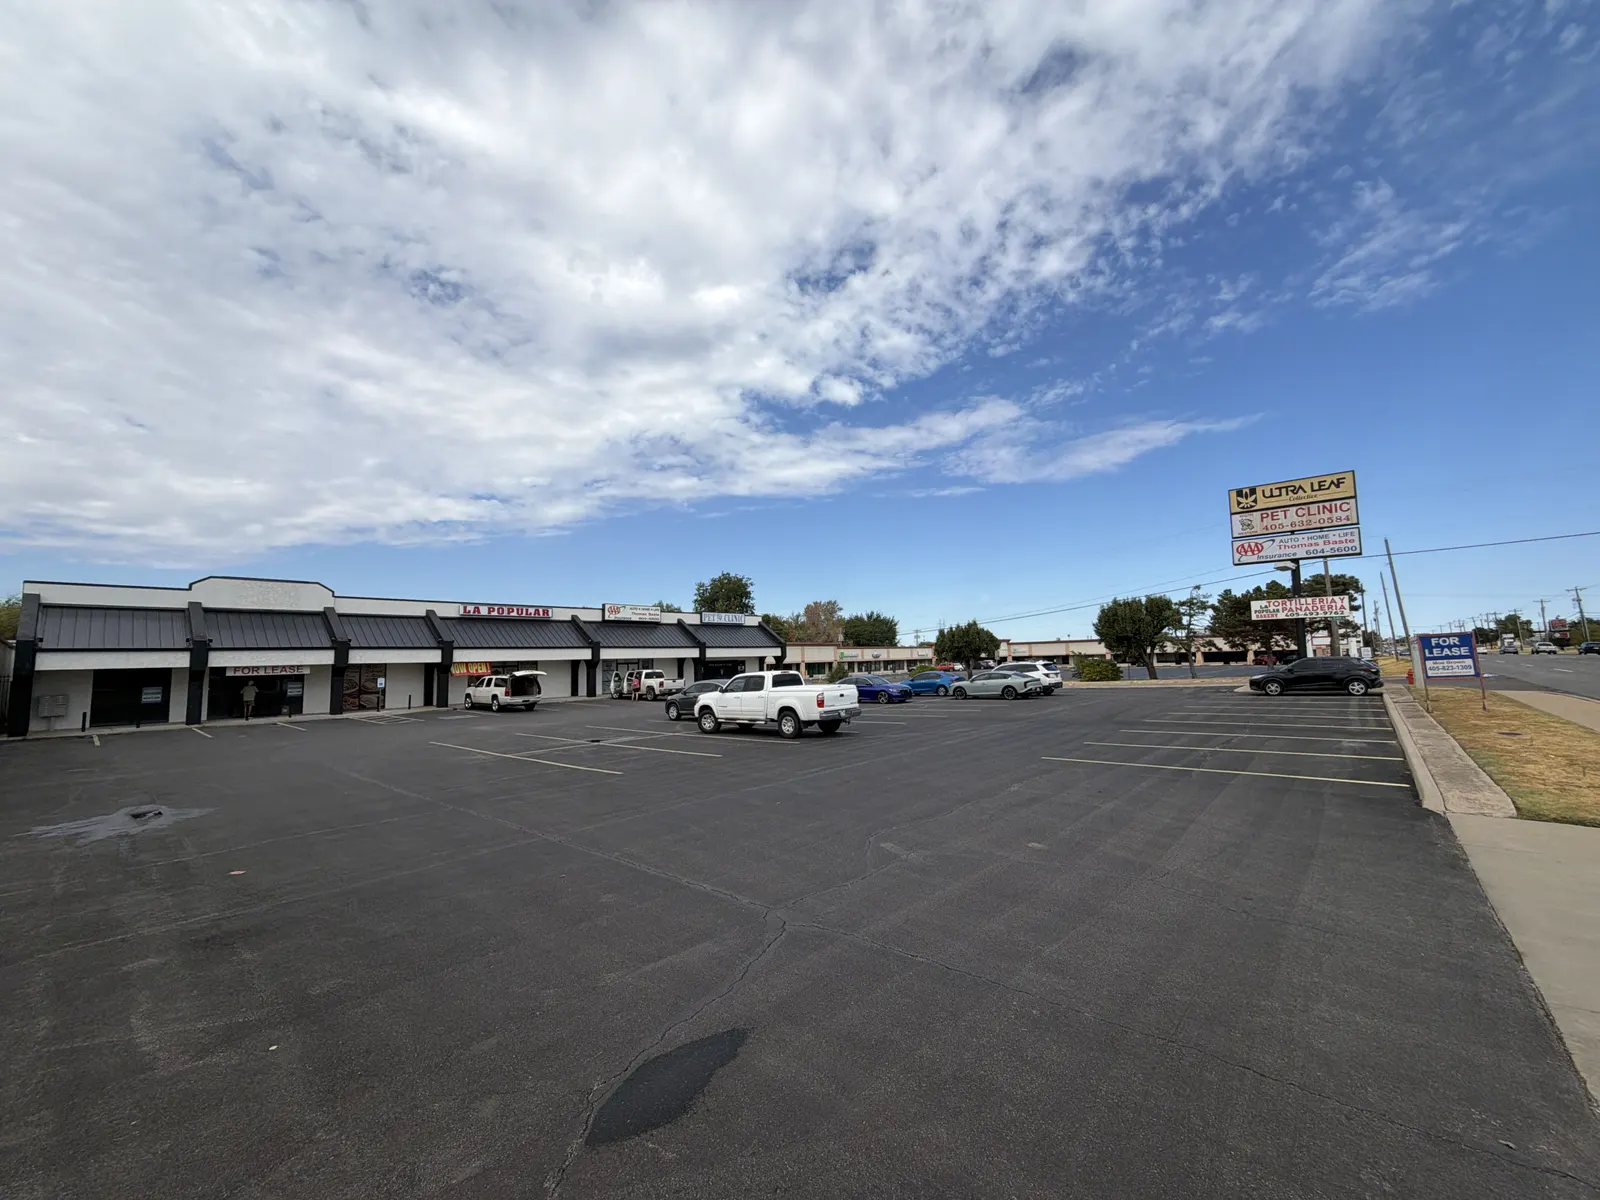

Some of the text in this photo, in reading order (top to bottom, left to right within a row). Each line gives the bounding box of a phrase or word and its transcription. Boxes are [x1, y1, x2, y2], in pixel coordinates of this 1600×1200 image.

[1262, 477, 1346, 499] ULTRA LEAF
[1289, 493, 1318, 502] Collective
[1260, 502, 1351, 522] PET CLINIC
[1262, 515, 1351, 531] 405-632-0584
[1307, 533, 1330, 541] HOME
[1239, 543, 1261, 555] AAA
[1277, 542, 1320, 550] Thomas
[1305, 545, 1358, 556] 604-5600
[1257, 551, 1297, 560] Insurance
[1266, 596, 1346, 608] TORTILLERIA Y
[463, 606, 550, 617] LA POPULAR
[1281, 604, 1347, 613] PANADERIA
[703, 613, 745, 623] PET CLINIC
[1285, 610, 1345, 618] 405-493-9762
[1430, 636, 1460, 646] FOR
[1425, 647, 1471, 657] LEASE
[233, 665, 305, 675] FOR LEASE
[468, 662, 491, 673] OPEN!
